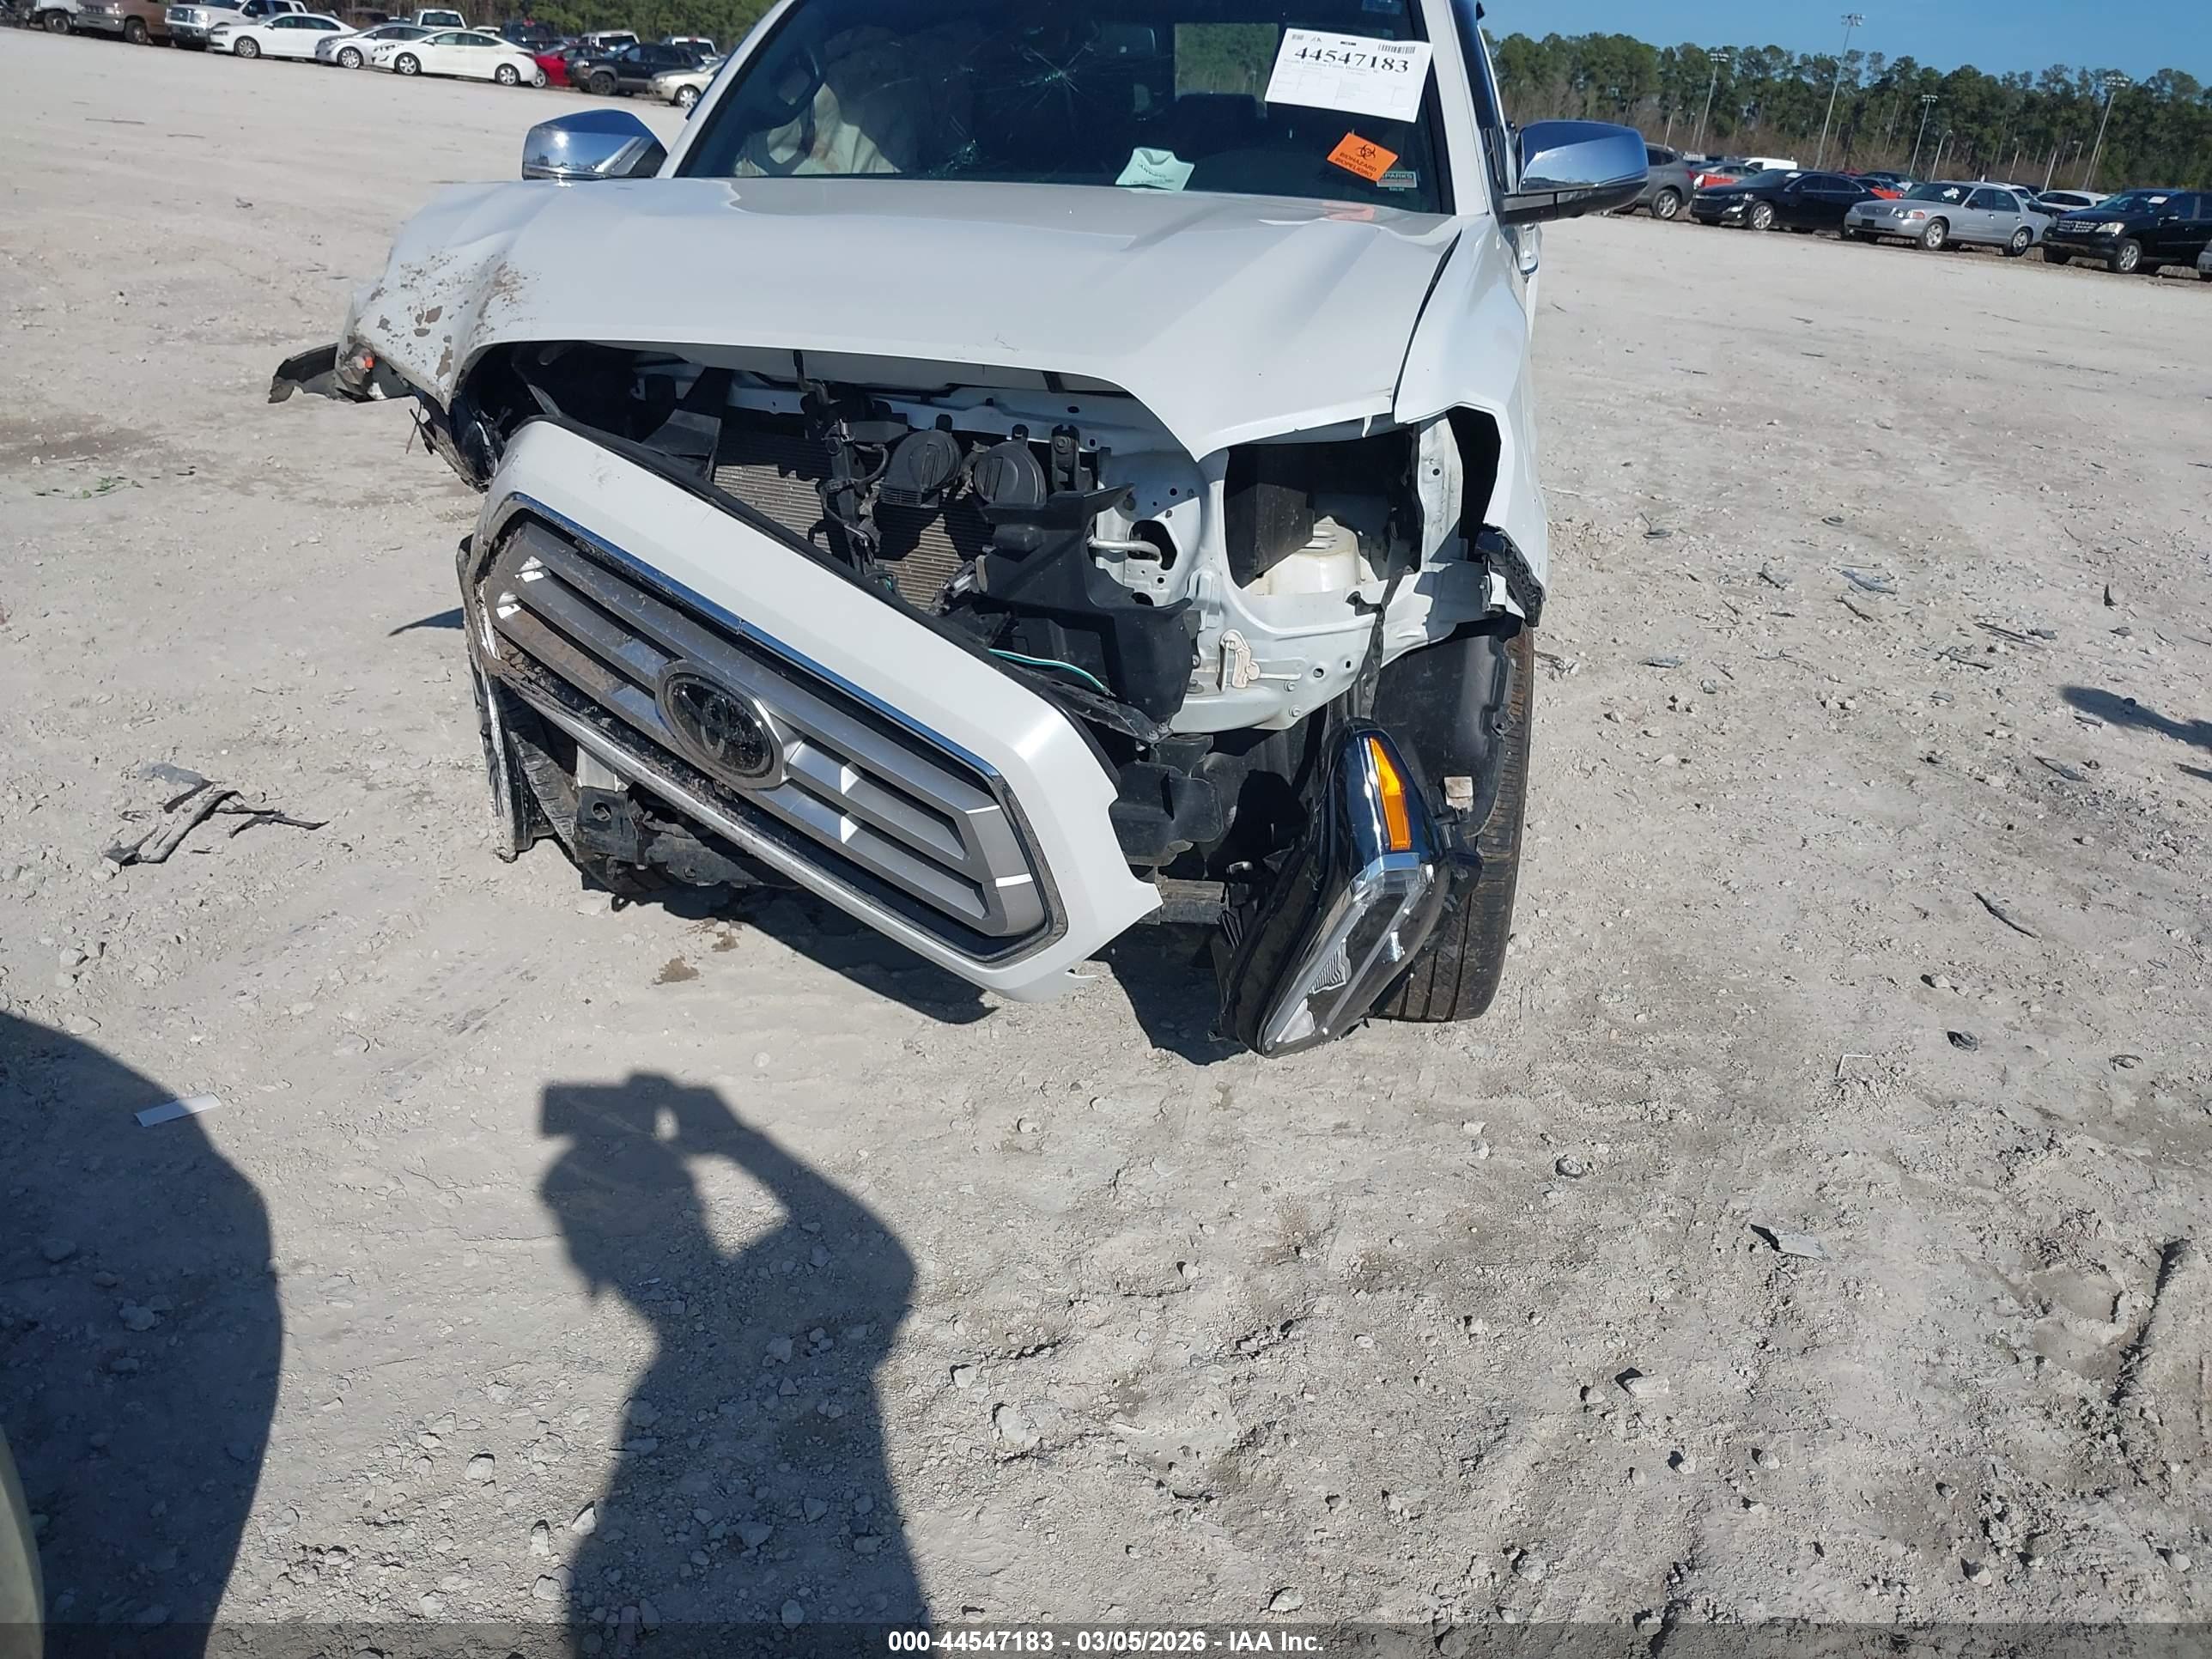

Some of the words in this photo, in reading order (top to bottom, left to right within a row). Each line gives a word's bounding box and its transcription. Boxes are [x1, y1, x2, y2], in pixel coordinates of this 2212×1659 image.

[1294, 46, 1409, 74] 44547183
[1334, 157, 1373, 178] BIOPELIGRO
[1339, 152, 1377, 173] BIOHAZARD
